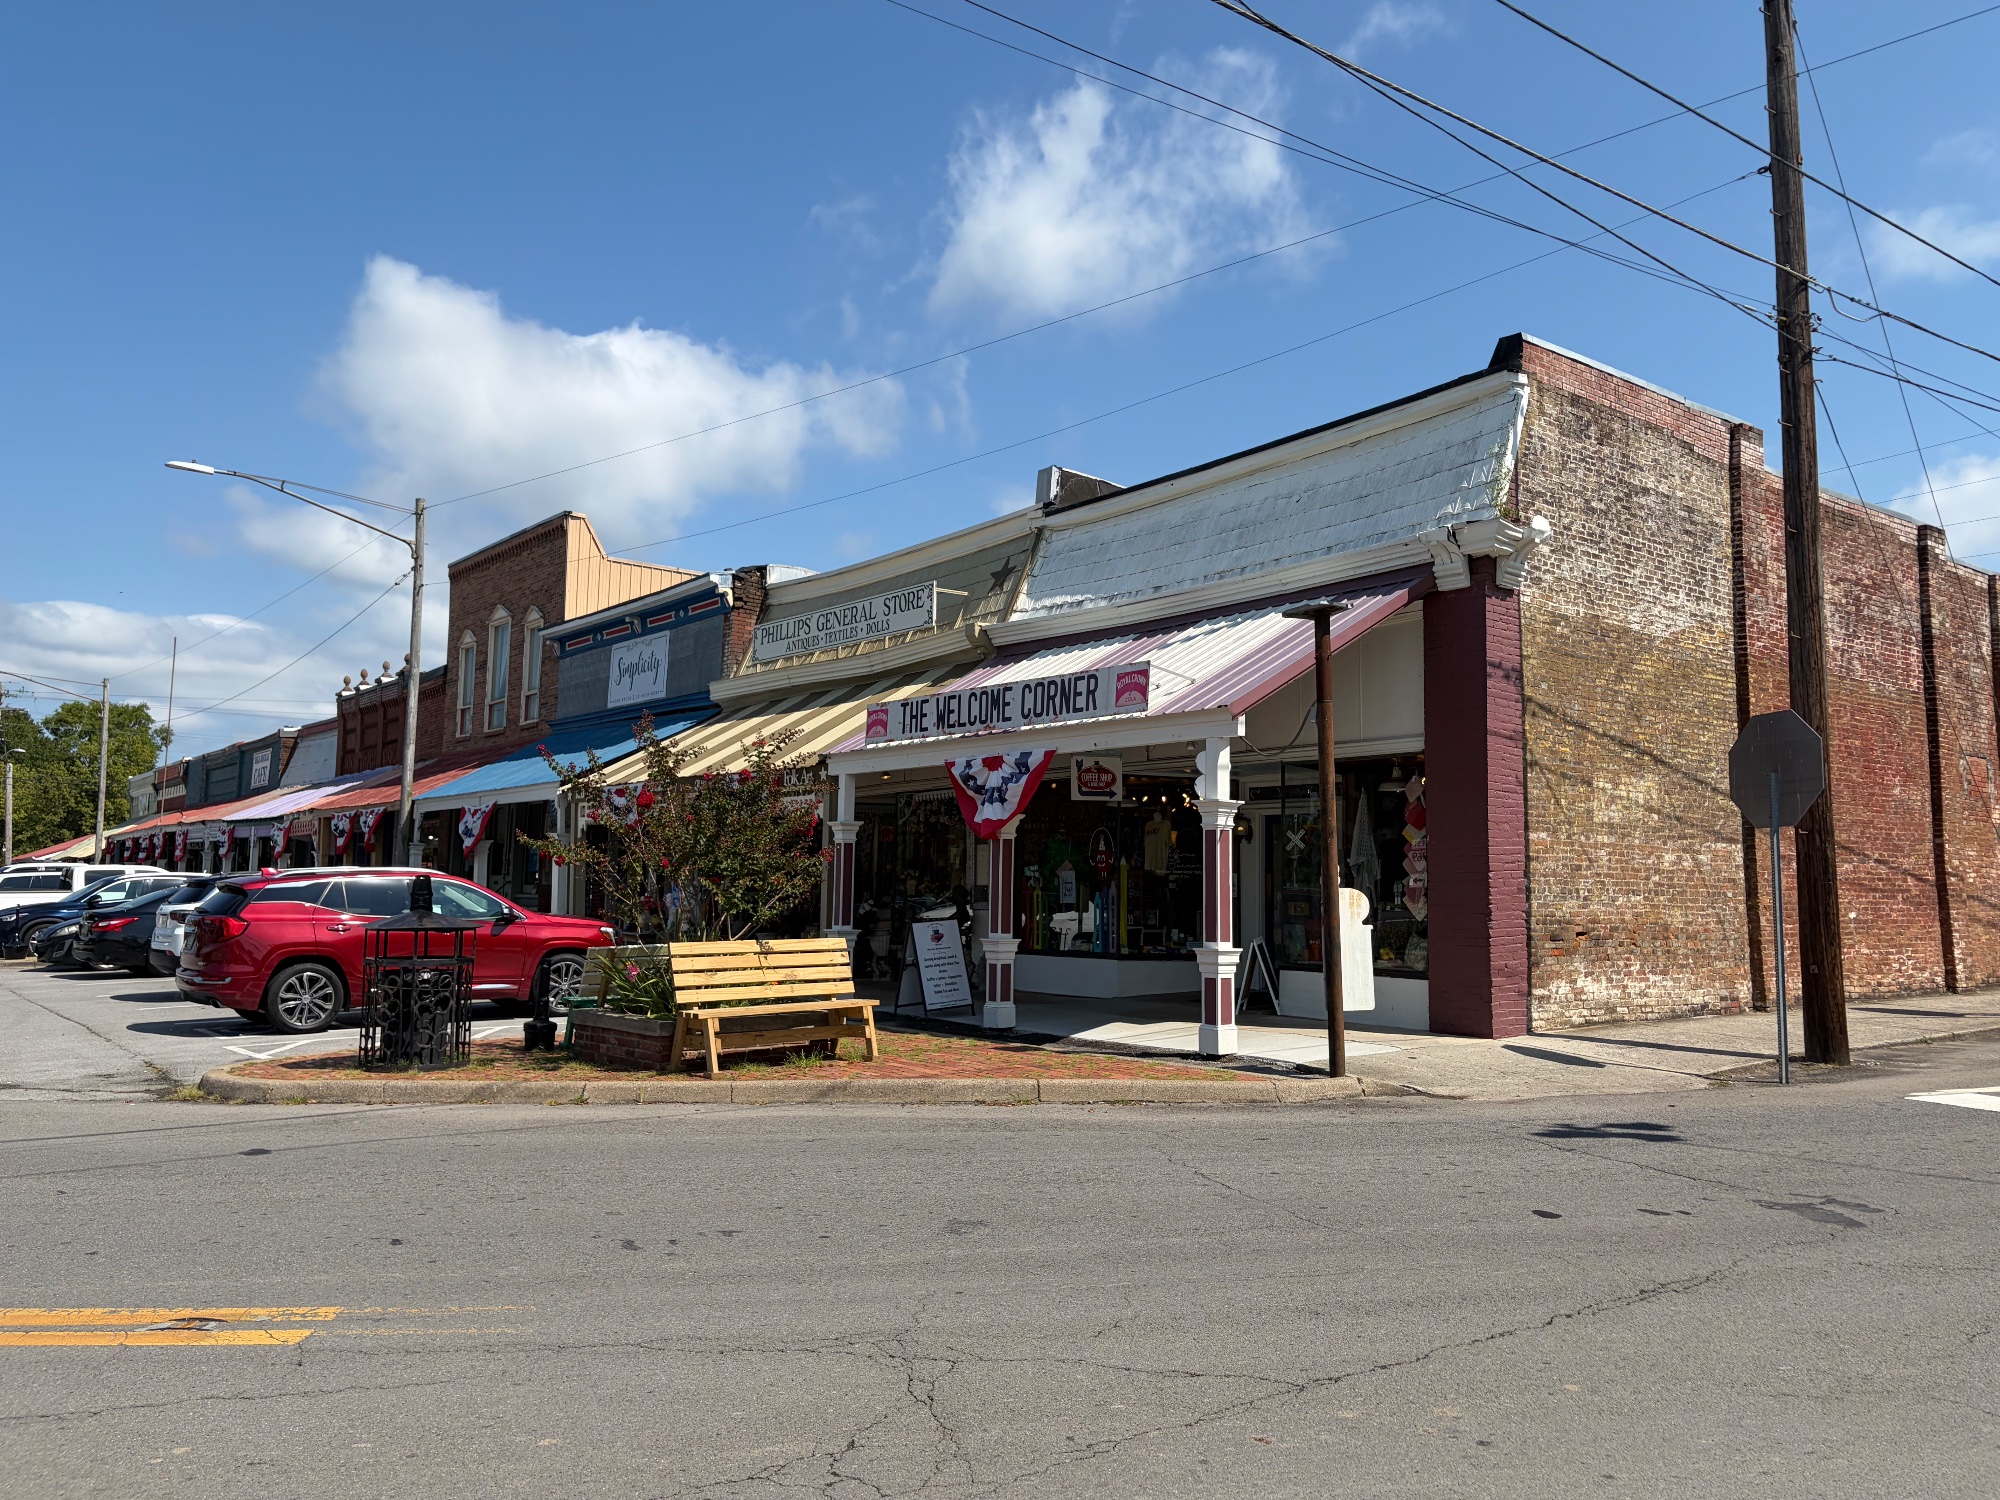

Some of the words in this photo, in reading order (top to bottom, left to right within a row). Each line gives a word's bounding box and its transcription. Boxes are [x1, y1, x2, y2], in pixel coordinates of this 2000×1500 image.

[760, 615, 813, 645] PHILLIPS'
[816, 601, 877, 632] GENERAL
[883, 587, 925, 617] STORE
[785, 635, 820, 653] ANTIQUES
[823, 626, 859, 645] TEXTILES
[866, 618, 891, 635] DOLLS
[614, 650, 663, 691] Simplicity
[900, 698, 929, 734] THE
[936, 685, 1013, 730] WELCOME
[1020, 673, 1099, 720] CORNER
[1081, 772, 1099, 783] COFFEE
[1099, 773, 1113, 783] SHOP
